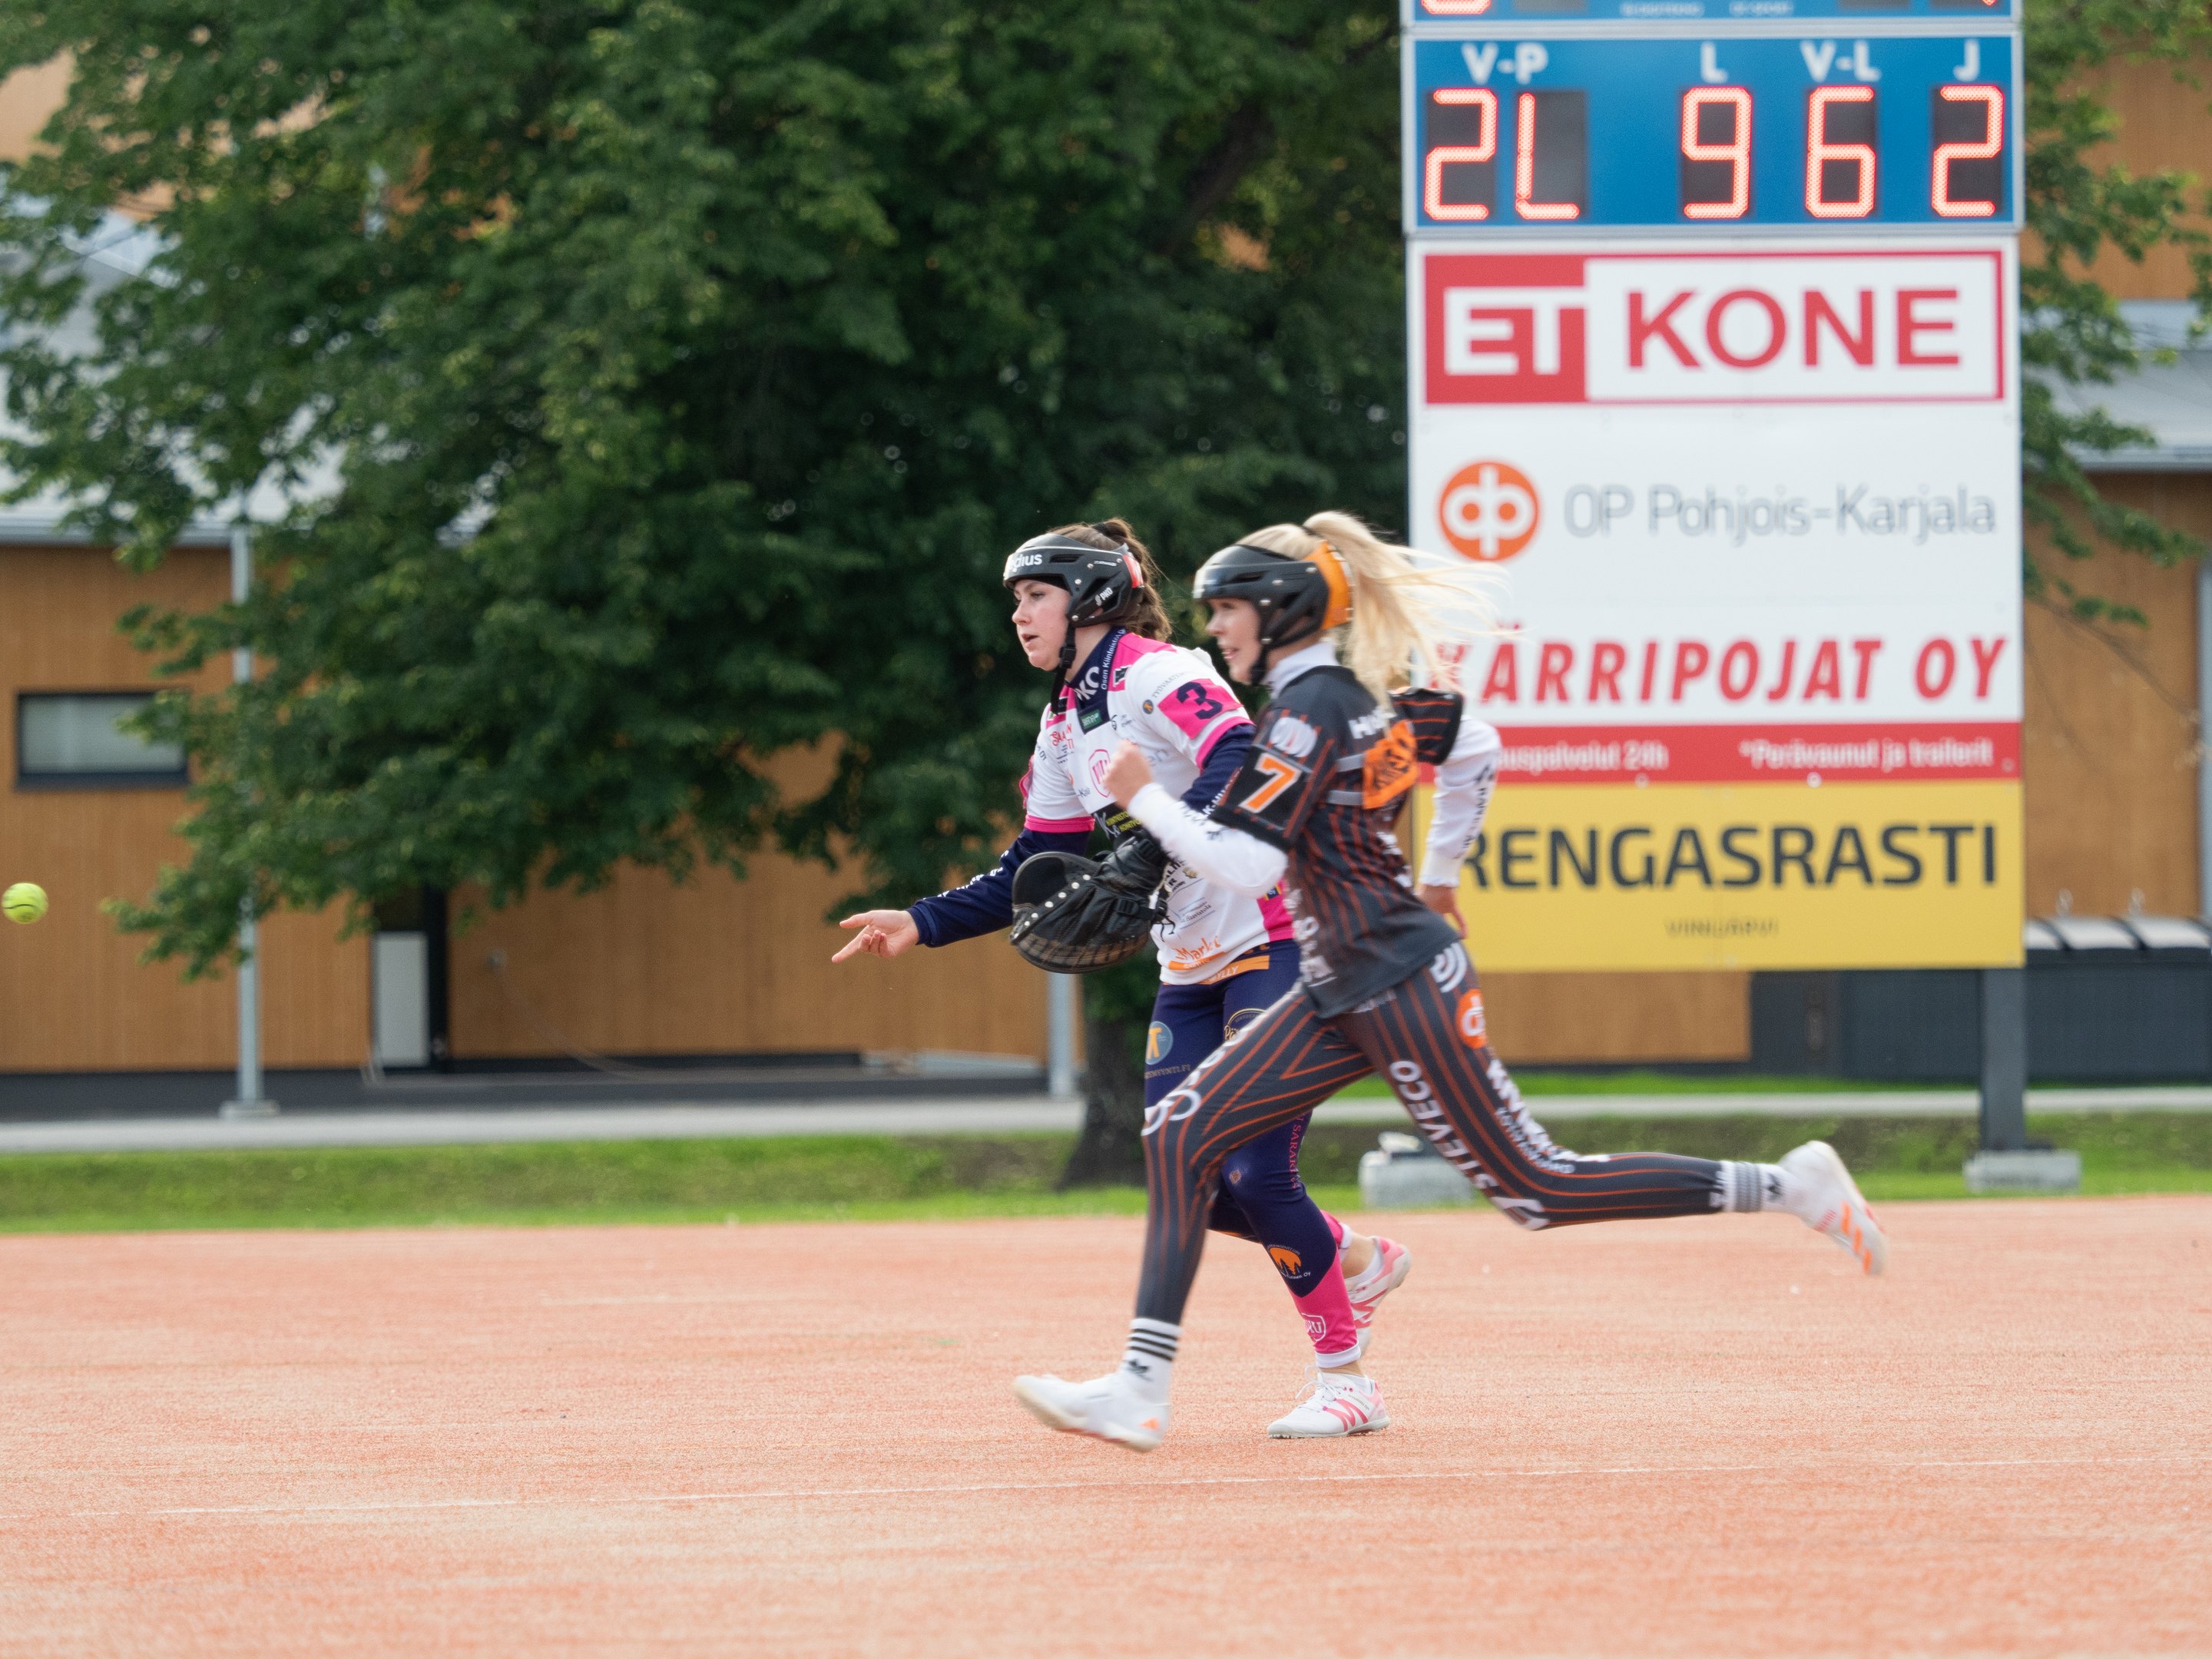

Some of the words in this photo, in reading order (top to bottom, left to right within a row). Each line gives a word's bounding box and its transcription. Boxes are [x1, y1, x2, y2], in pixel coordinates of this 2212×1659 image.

[1461, 42, 1548, 84] V-P
[1699, 42, 1728, 84] L
[1800, 40, 1882, 83] V-L
[1954, 39, 1982, 81] J
[1682, 87, 1753, 219] 9
[1805, 86, 1876, 218] 6
[1932, 84, 2004, 217] 2
[1443, 286, 1584, 376] ET
[1625, 288, 1962, 370] KONE
[1562, 484, 1636, 539] OP
[1647, 482, 1998, 547] Pohjois-Karjala
[1176, 680, 1224, 720] 3
[1913, 637, 2008, 700] OY
[1240, 753, 1303, 814] 7
[1881, 737, 1907, 773] ja
[1463, 823, 1997, 890] RENGASRASTI
